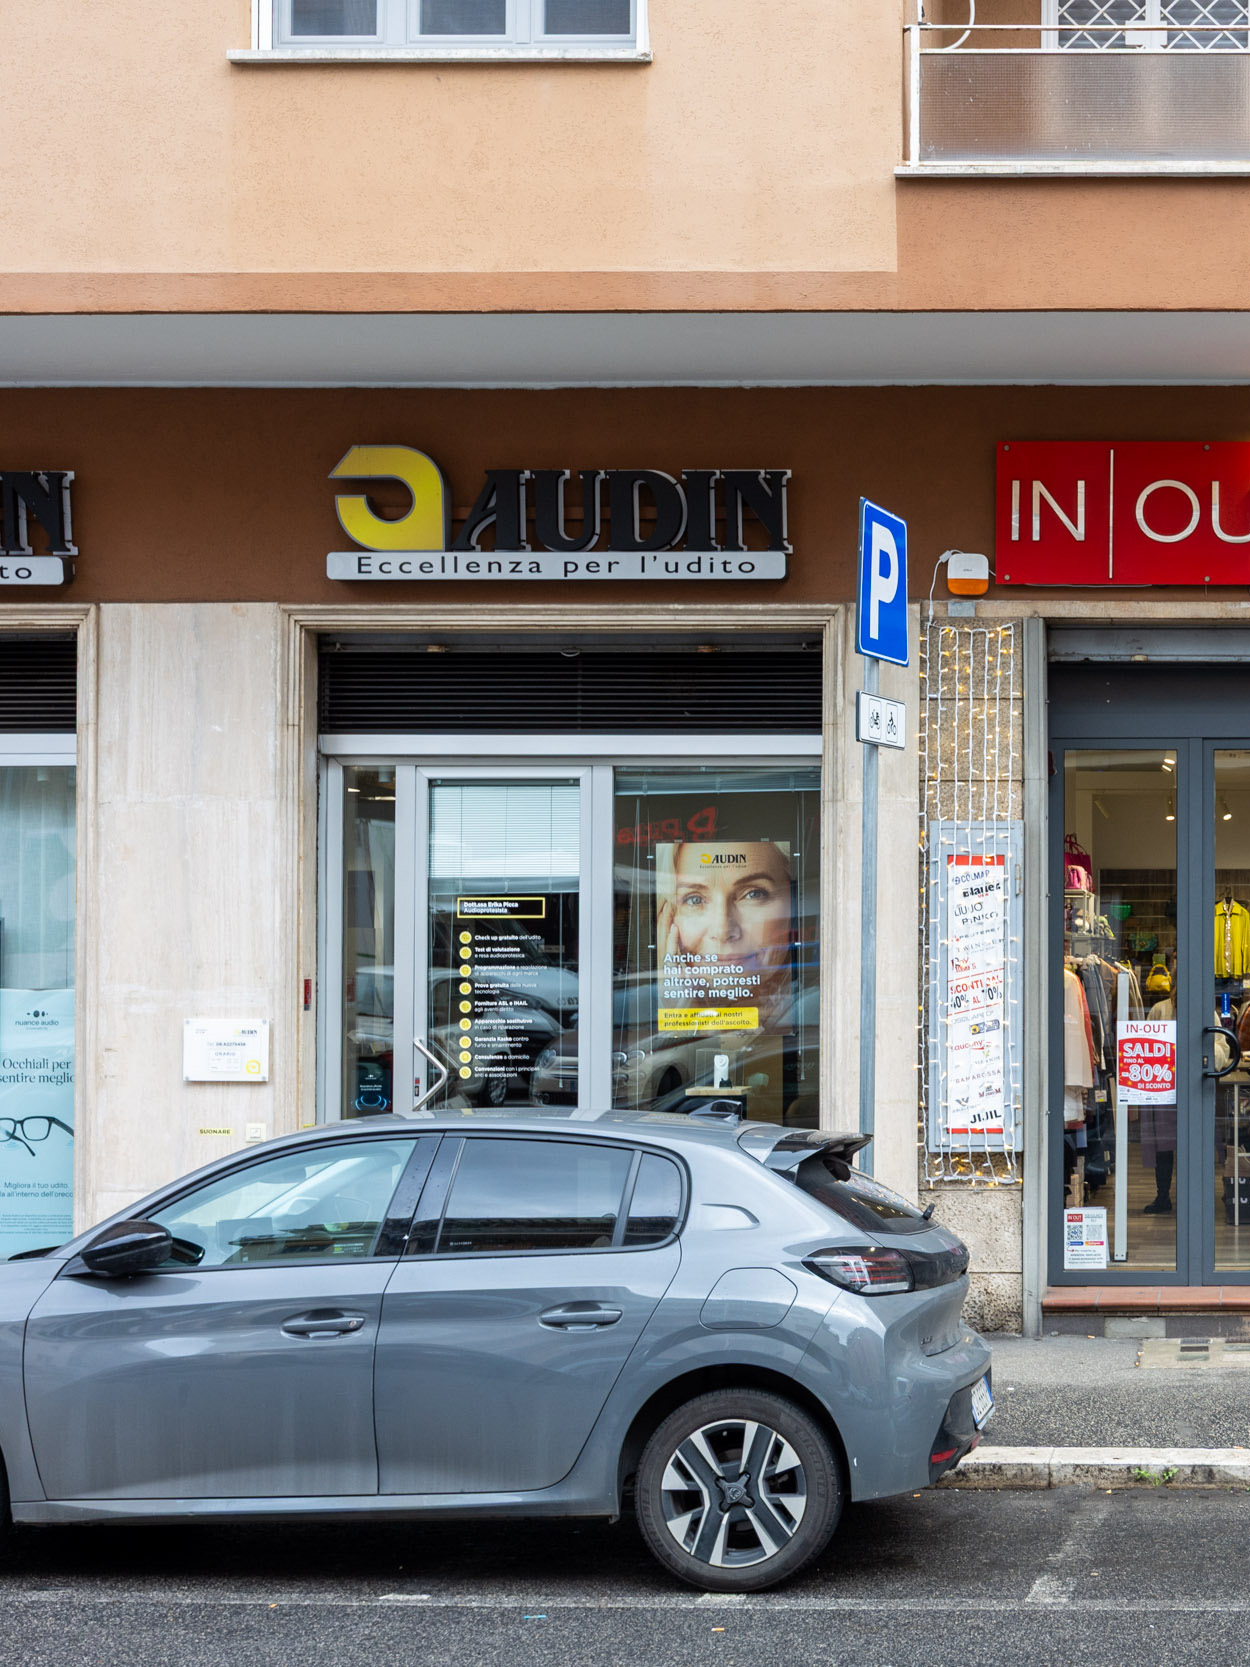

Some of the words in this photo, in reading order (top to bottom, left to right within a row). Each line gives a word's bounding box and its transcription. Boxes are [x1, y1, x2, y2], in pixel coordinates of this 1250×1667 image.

[450, 469, 794, 554] AUDIN
[1011, 480, 1086, 542] IN
[357, 556, 542, 575] Eccellenza
[564, 558, 620, 578] per
[641, 556, 756, 575] l'udito
[870, 521, 898, 640] P
[712, 854, 746, 864] AUDIN
[664, 953, 701, 962] Anche
[705, 954, 718, 962] se
[664, 965, 681, 974] hai
[684, 964, 744, 976] comprato
[664, 976, 710, 988] altrove,
[713, 975, 760, 987] potresti
[664, 988, 705, 998] sentire
[708, 988, 754, 999] meglio.
[1126, 1024, 1168, 1033] IN-OUT
[1123, 1043, 1171, 1057] SALDI
[3, 1058, 48, 1069] Occhiali
[52, 1060, 71, 1072] per
[1122, 1064, 1172, 1082] -80%
[4, 1182, 31, 1190] Migliora
